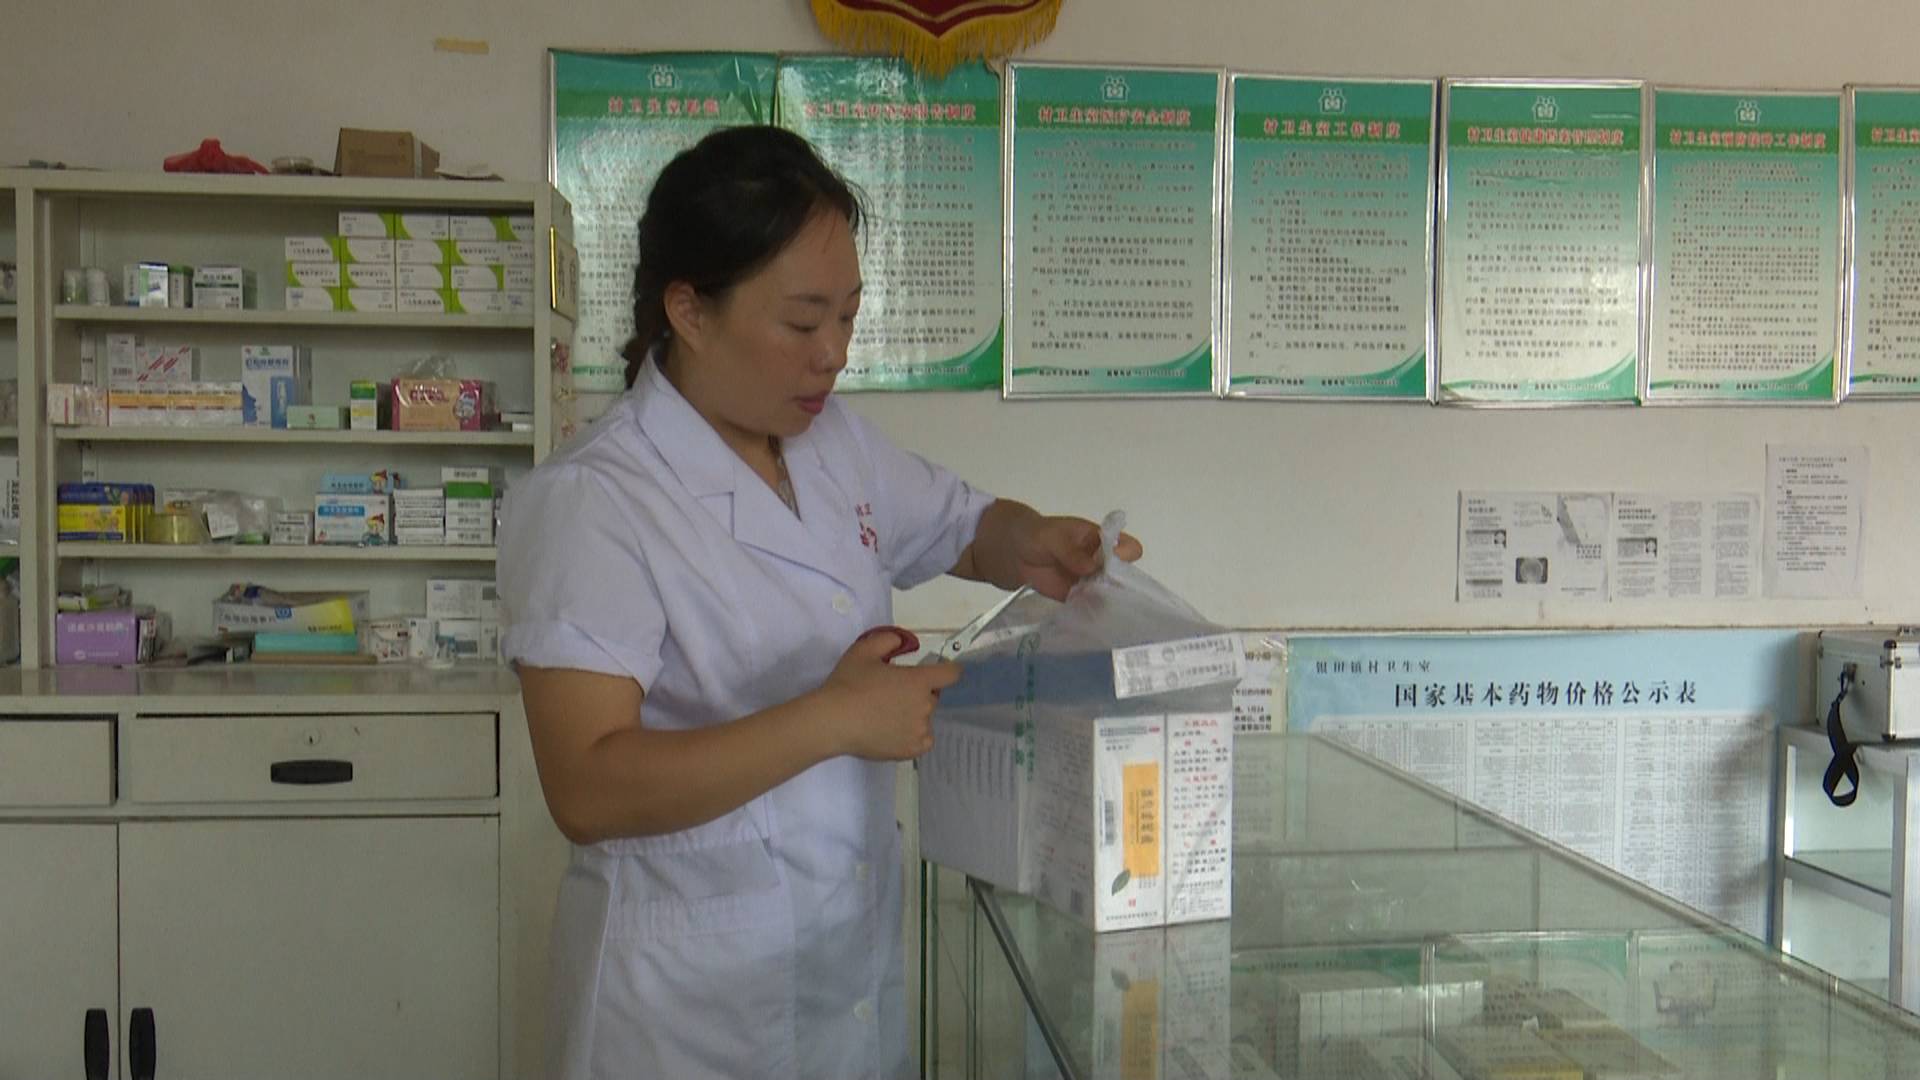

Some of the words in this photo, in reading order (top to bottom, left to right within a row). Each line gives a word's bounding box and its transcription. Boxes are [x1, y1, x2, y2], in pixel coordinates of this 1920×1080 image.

[1263, 117, 1401, 138] 村卫生室工作制度
[1394, 679, 1697, 707] 国家基本药物价格公示表
